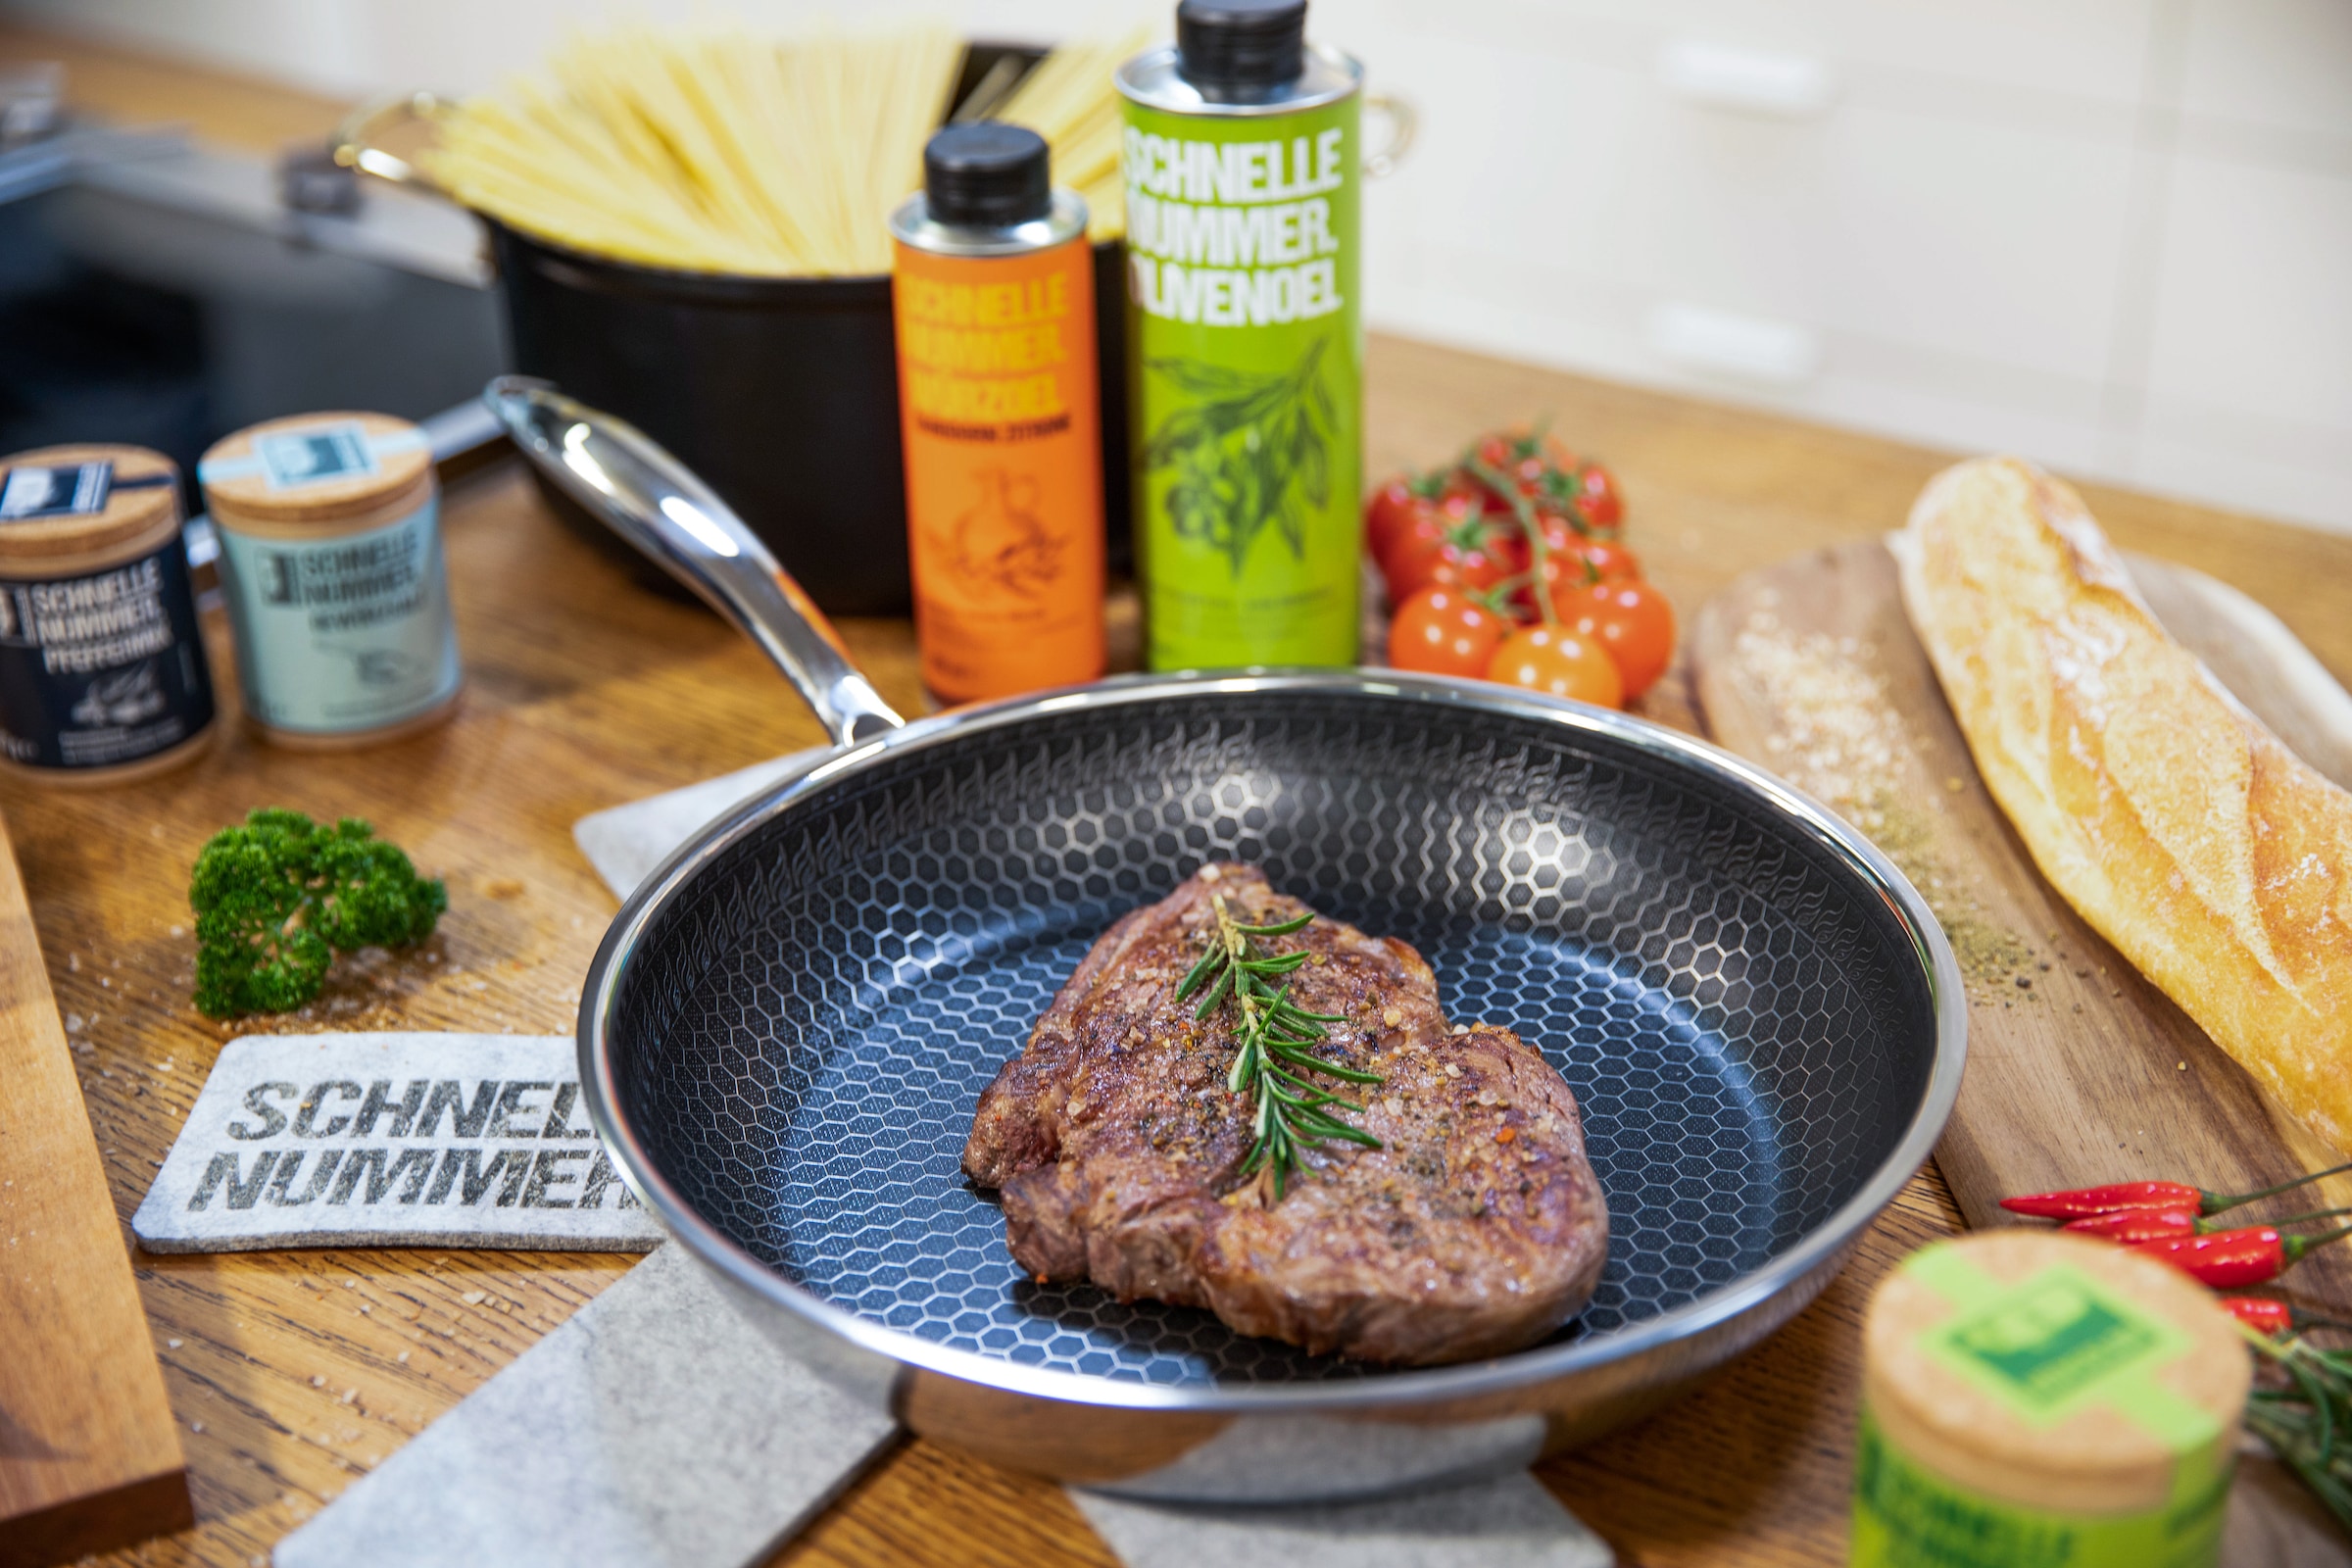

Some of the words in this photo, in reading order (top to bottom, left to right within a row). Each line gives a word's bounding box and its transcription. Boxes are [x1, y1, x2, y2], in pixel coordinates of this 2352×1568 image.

[1125, 125, 1344, 204] SCHNELLE
[31, 557, 164, 615] SCHNELLE
[226, 1079, 600, 1140] SCHNEL
